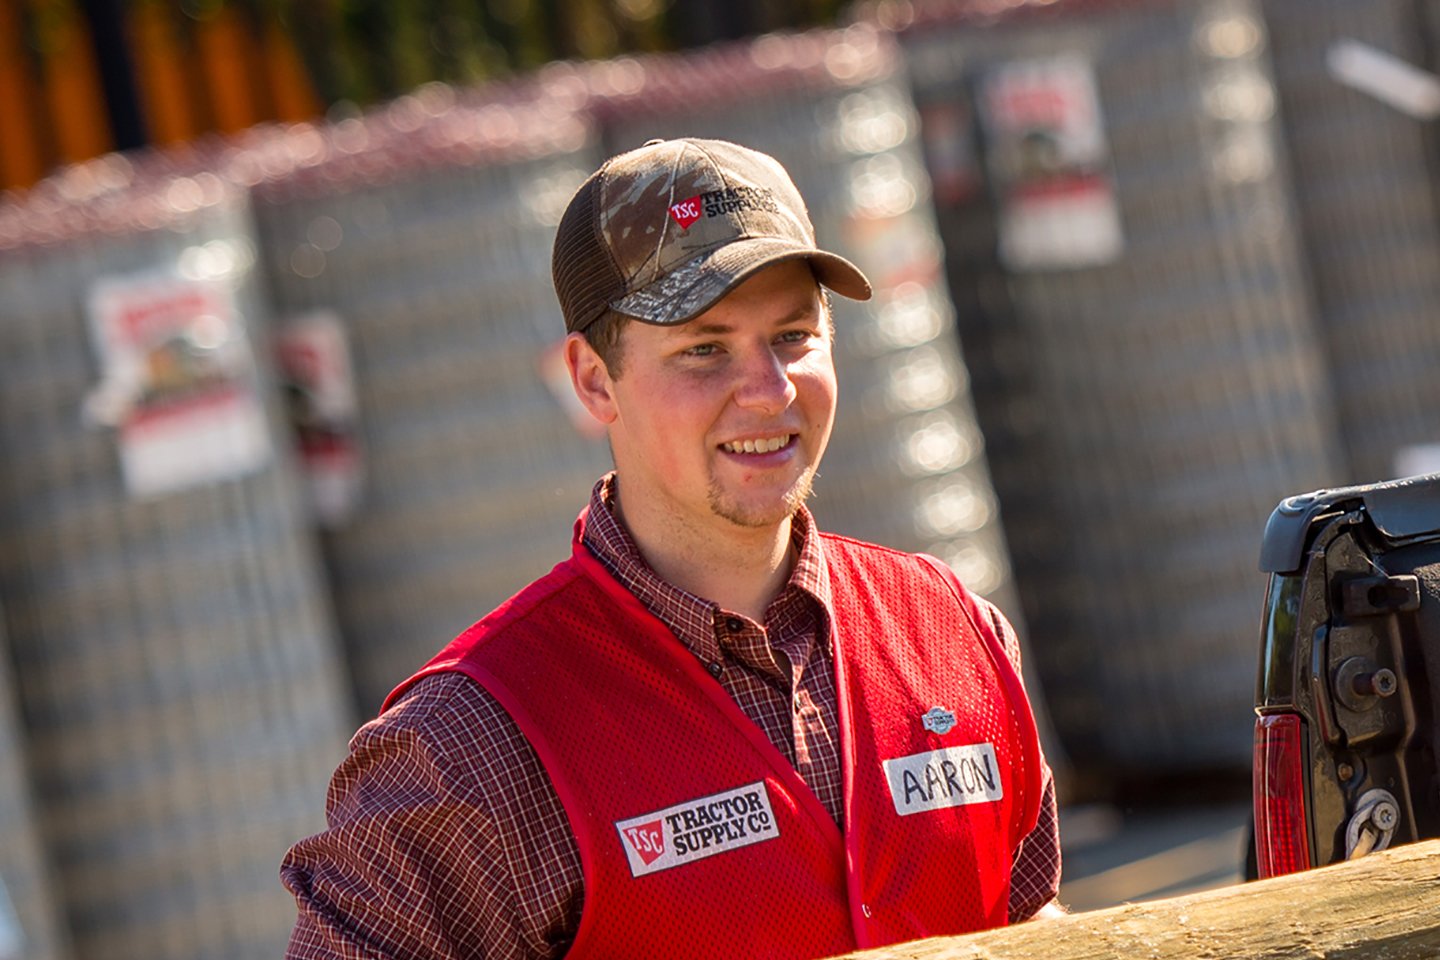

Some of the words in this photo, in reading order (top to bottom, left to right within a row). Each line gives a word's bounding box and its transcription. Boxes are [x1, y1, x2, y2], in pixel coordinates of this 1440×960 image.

[701, 186, 773, 204] TRACTOR
[671, 202, 698, 219] TSC
[705, 199, 762, 218] SUPPLY
[903, 754, 996, 804] AARON
[665, 791, 764, 835] TRACTOR
[628, 828, 663, 854] TSC
[672, 817, 747, 857] SUPPLY
